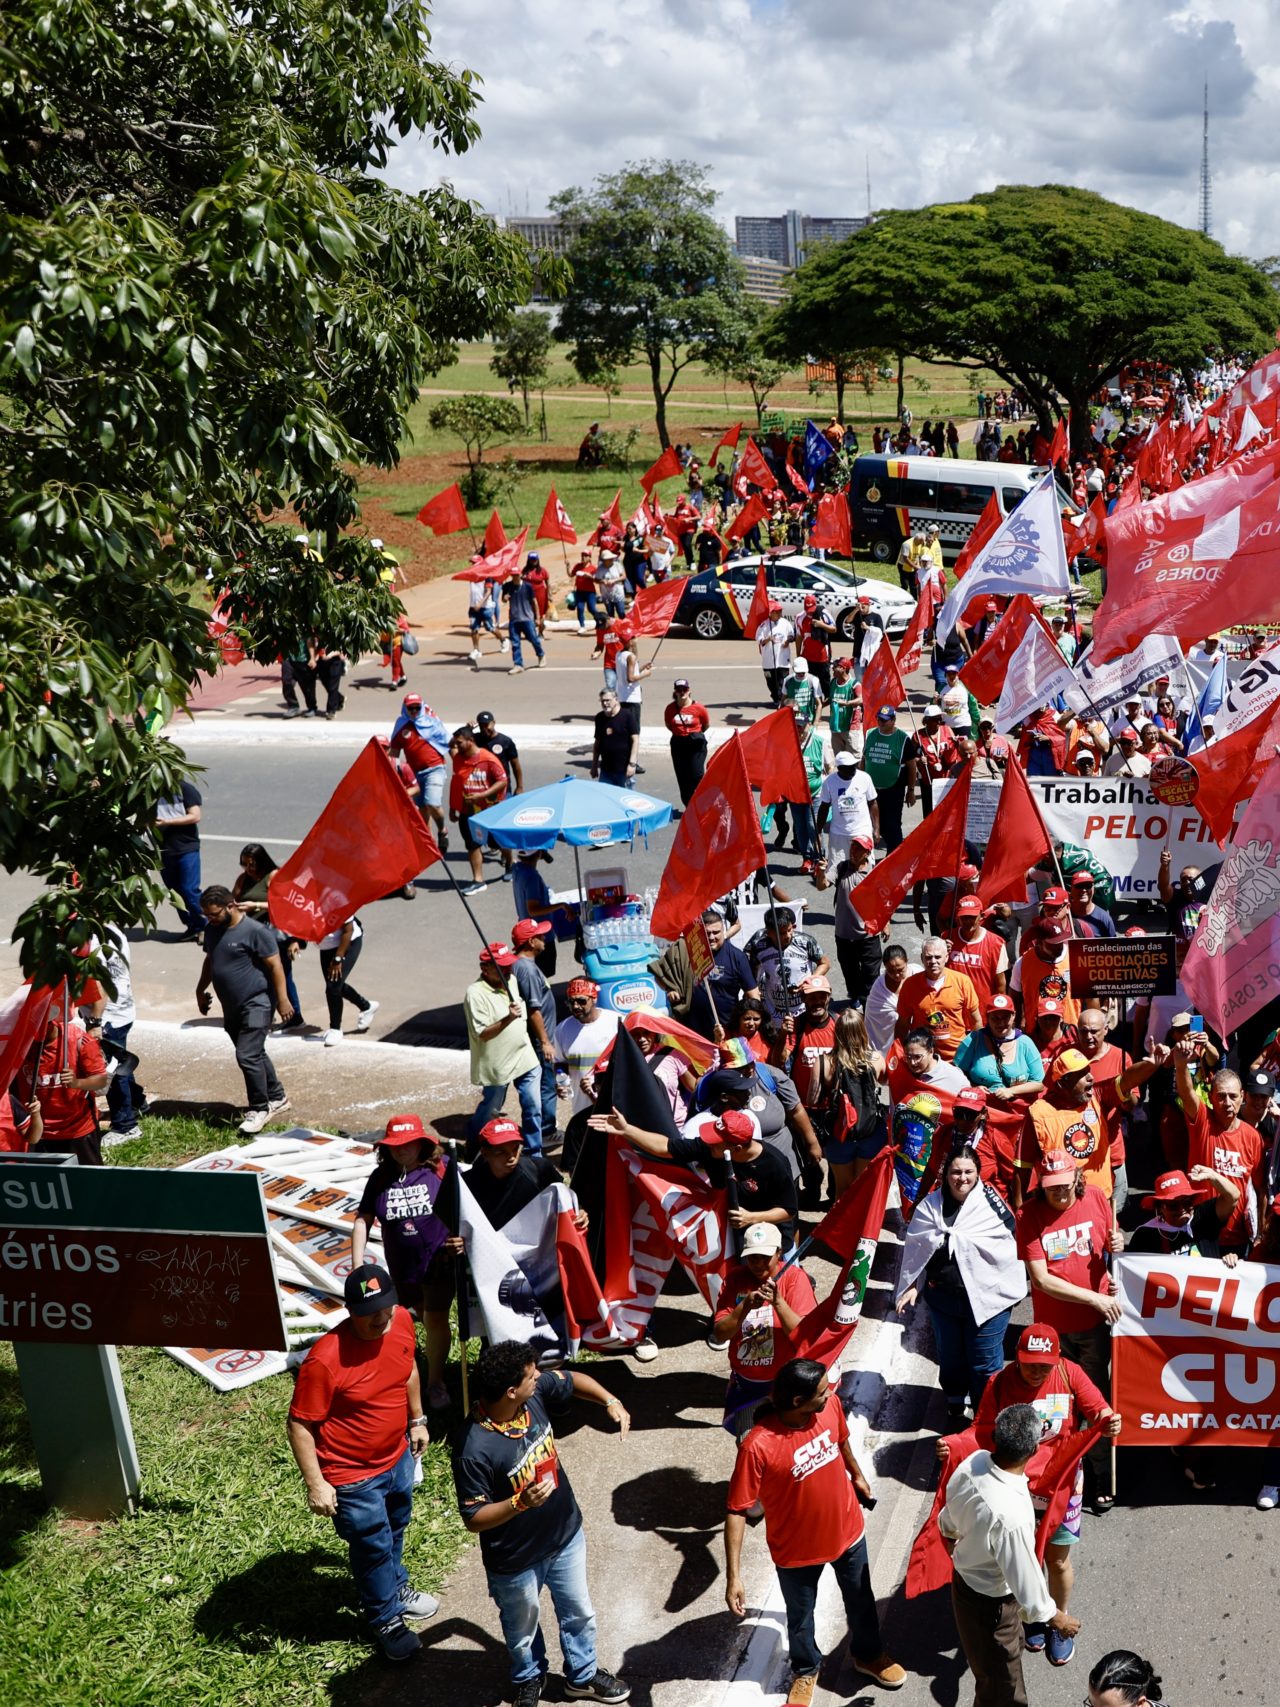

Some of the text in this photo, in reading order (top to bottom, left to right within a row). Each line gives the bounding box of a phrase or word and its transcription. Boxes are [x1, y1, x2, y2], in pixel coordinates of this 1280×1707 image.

[1083, 815, 1168, 841] PELO
[1083, 942, 1163, 953] Fortalecimento das
[1078, 951, 1169, 969] NEGOCIAÇÕES
[1088, 967, 1159, 981] COLETIVAS
[616, 991, 653, 1006] Nestlé
[3, 1173, 73, 1210] sul
[759, 1357, 774, 1366] MST
[1140, 1412, 1220, 1430] SANTA
